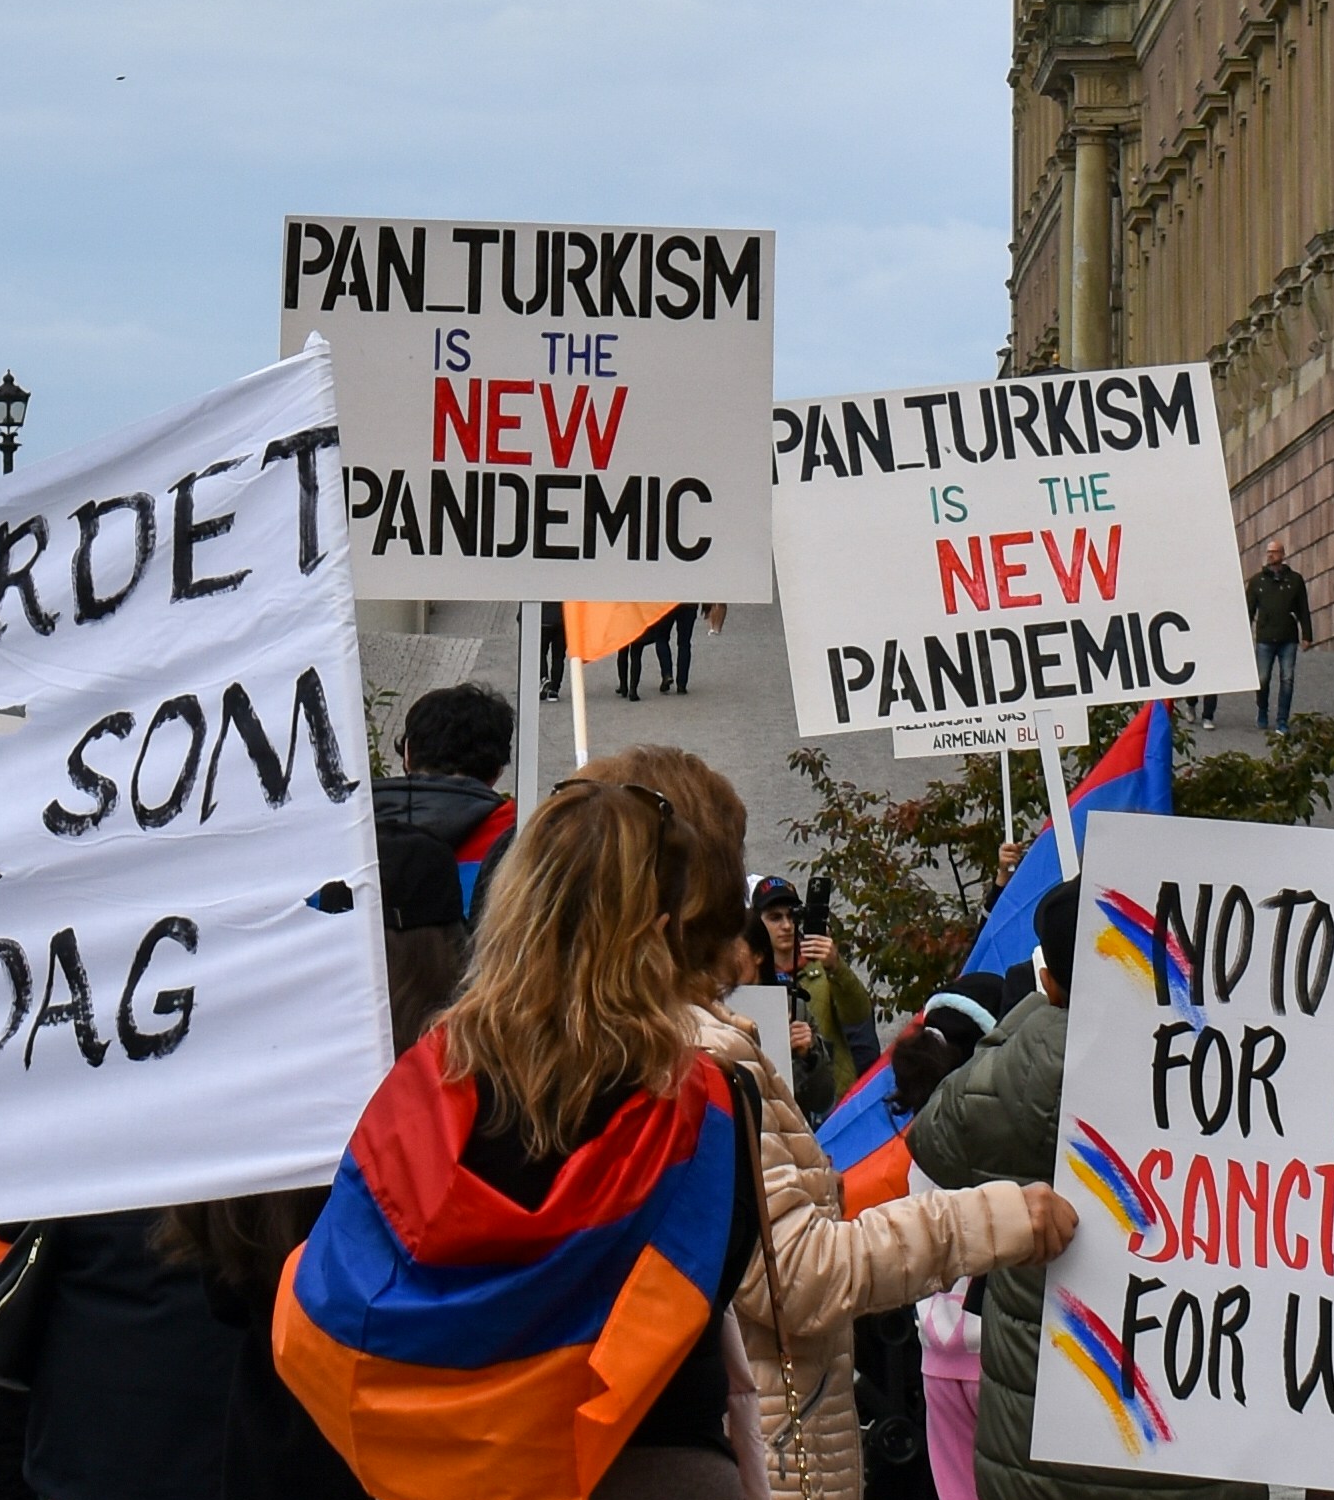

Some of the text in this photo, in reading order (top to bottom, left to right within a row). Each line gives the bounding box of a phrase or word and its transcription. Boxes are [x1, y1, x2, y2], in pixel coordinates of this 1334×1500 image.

[434, 328, 618, 378] IS THE
[433, 377, 628, 470] NEW
[343, 466, 712, 561] PANDEMIC
[931, 473, 1115, 523] IS THE
[936, 524, 1121, 614] NEW
[827, 612, 1195, 724] PANDEMIC
[43, 667, 360, 836] SOM
[933, 725, 1064, 750] ARMENIAN BLD
[1152, 1022, 1286, 1138] FOR
[1122, 1273, 1250, 1407] FOR
